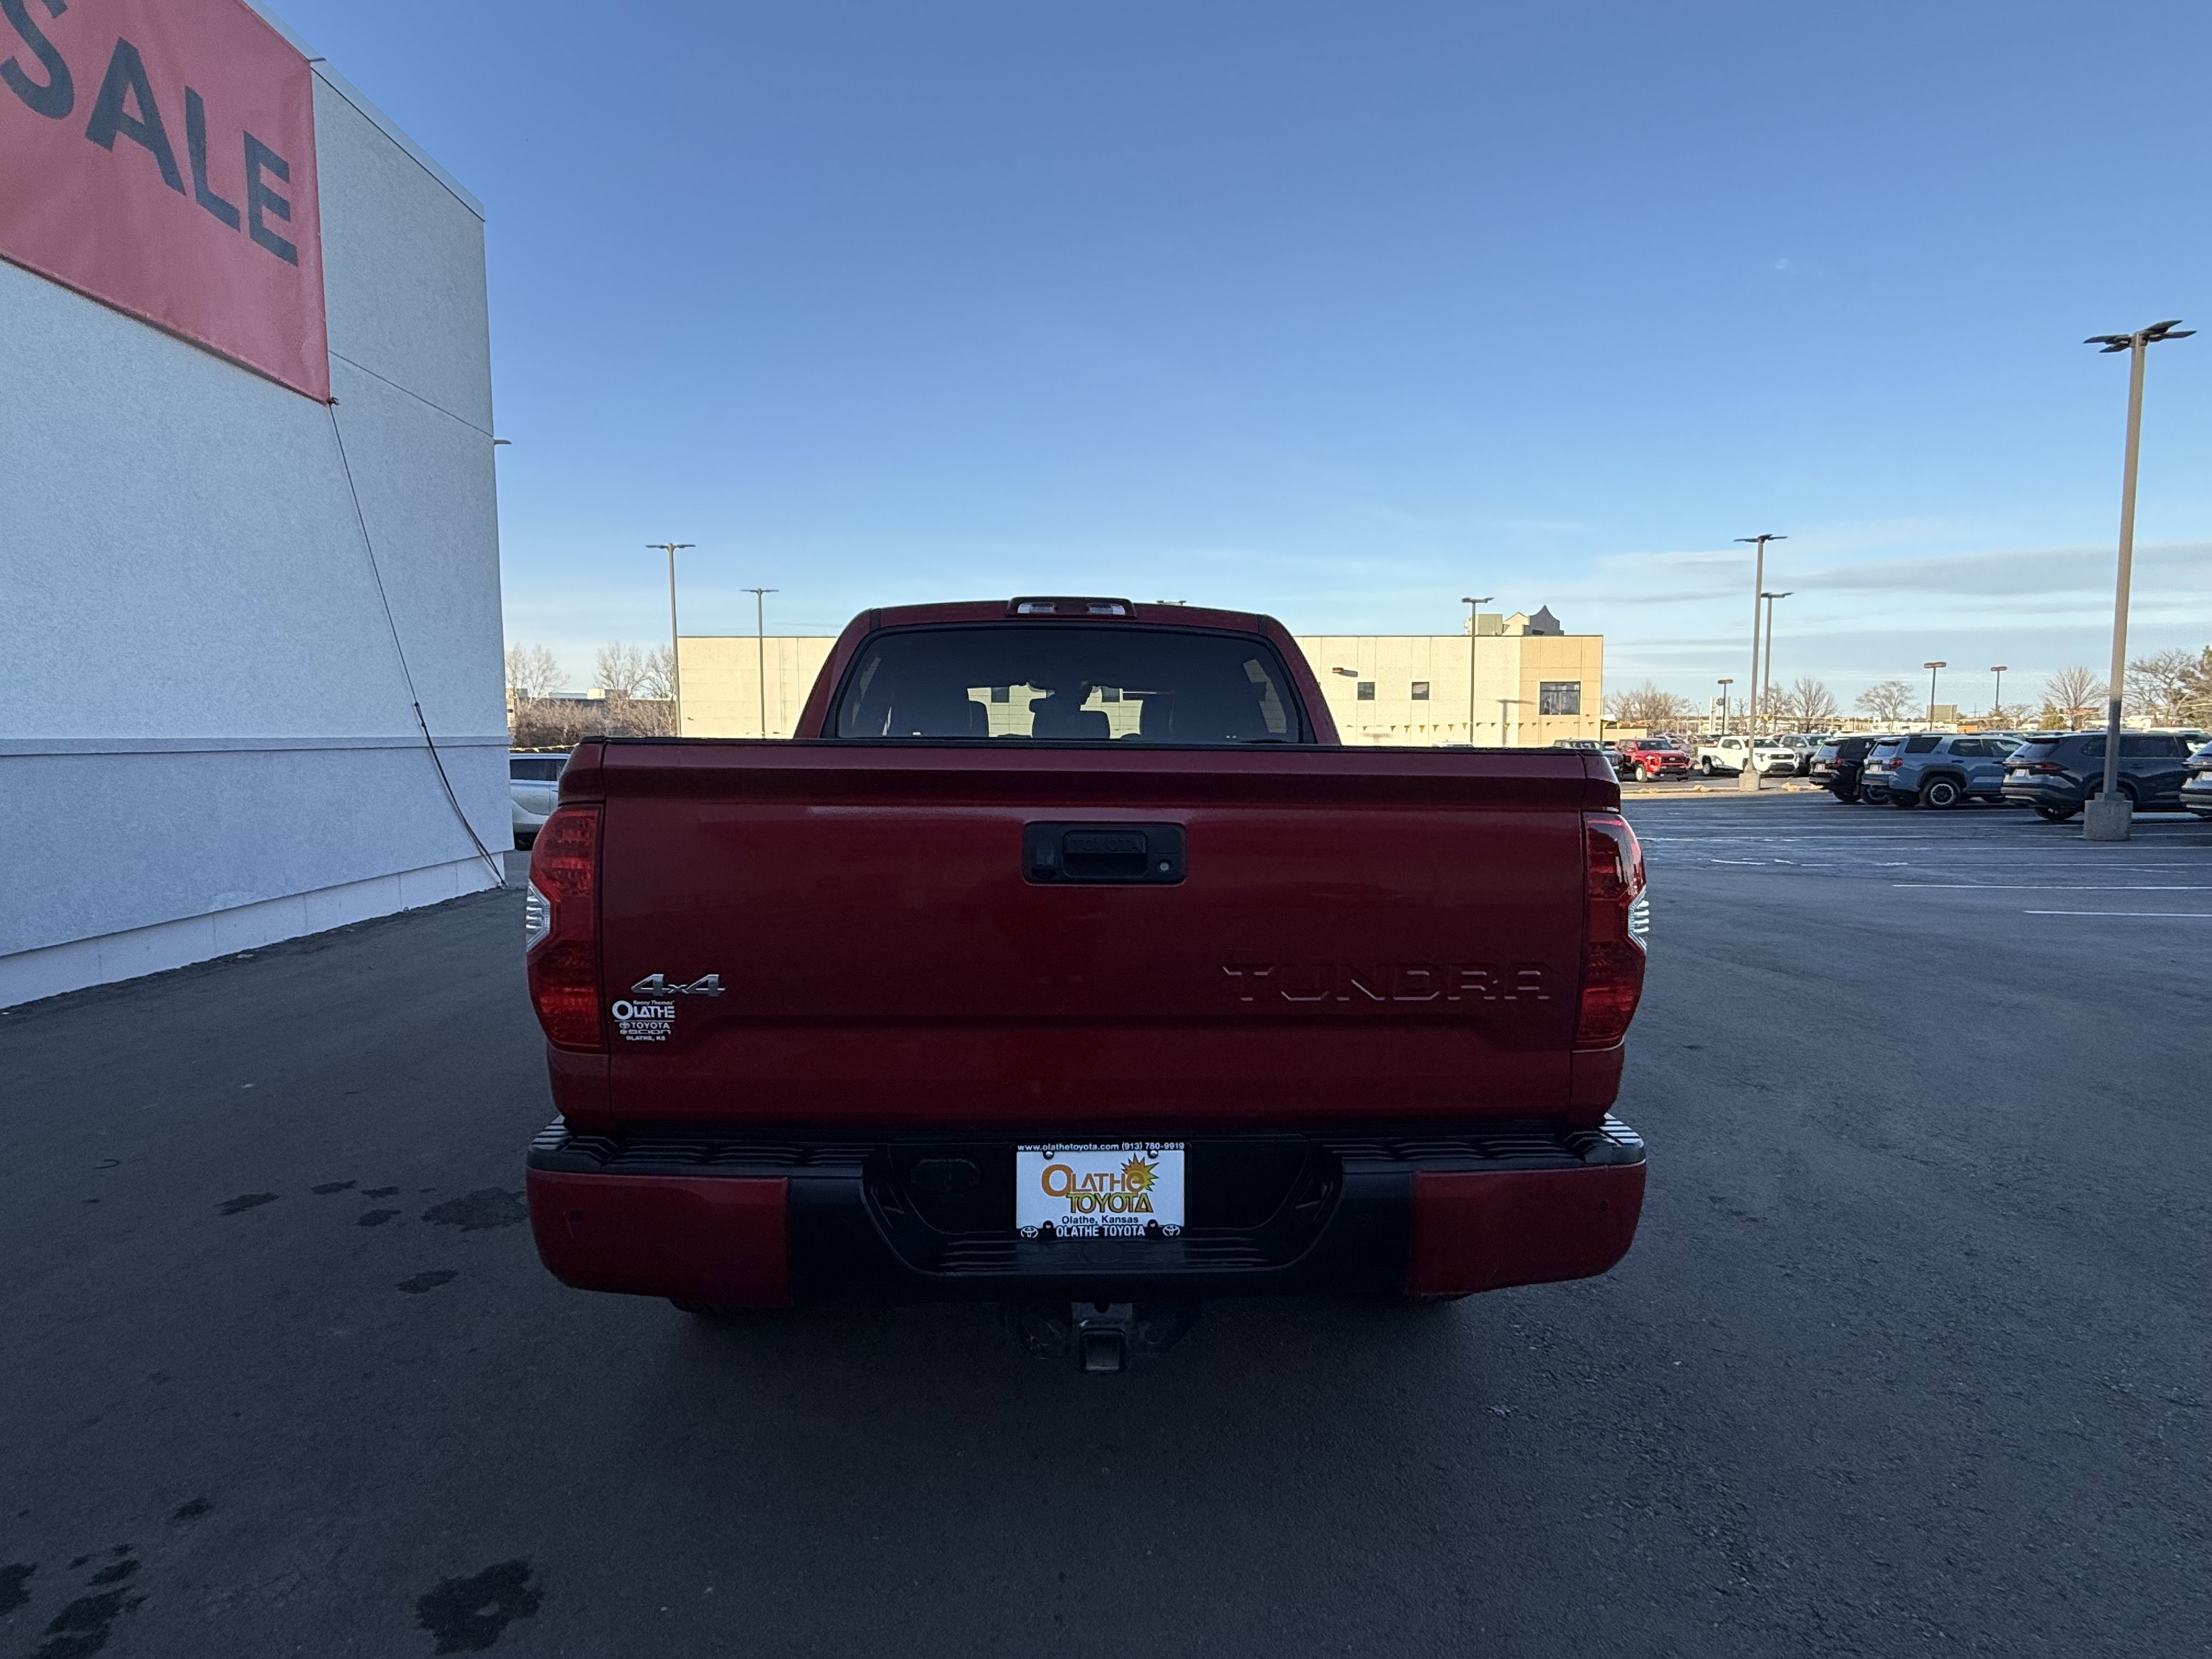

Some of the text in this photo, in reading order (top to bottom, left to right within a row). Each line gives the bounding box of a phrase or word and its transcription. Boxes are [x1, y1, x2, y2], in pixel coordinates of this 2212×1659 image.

[0, 0, 298, 267] SALE
[1222, 964, 1551, 1000] TUNDRA
[612, 1000, 675, 1020] OLATHE
[1017, 1143, 1119, 1152] www.olathetoyota.com
[1122, 1142, 1142, 1150] (913)
[1066, 1193, 1154, 1213] TOYOTA
[1062, 1215, 1139, 1225] Olathe, Kansas
[1056, 1224, 1146, 1238] OLATHE TOYOTA
